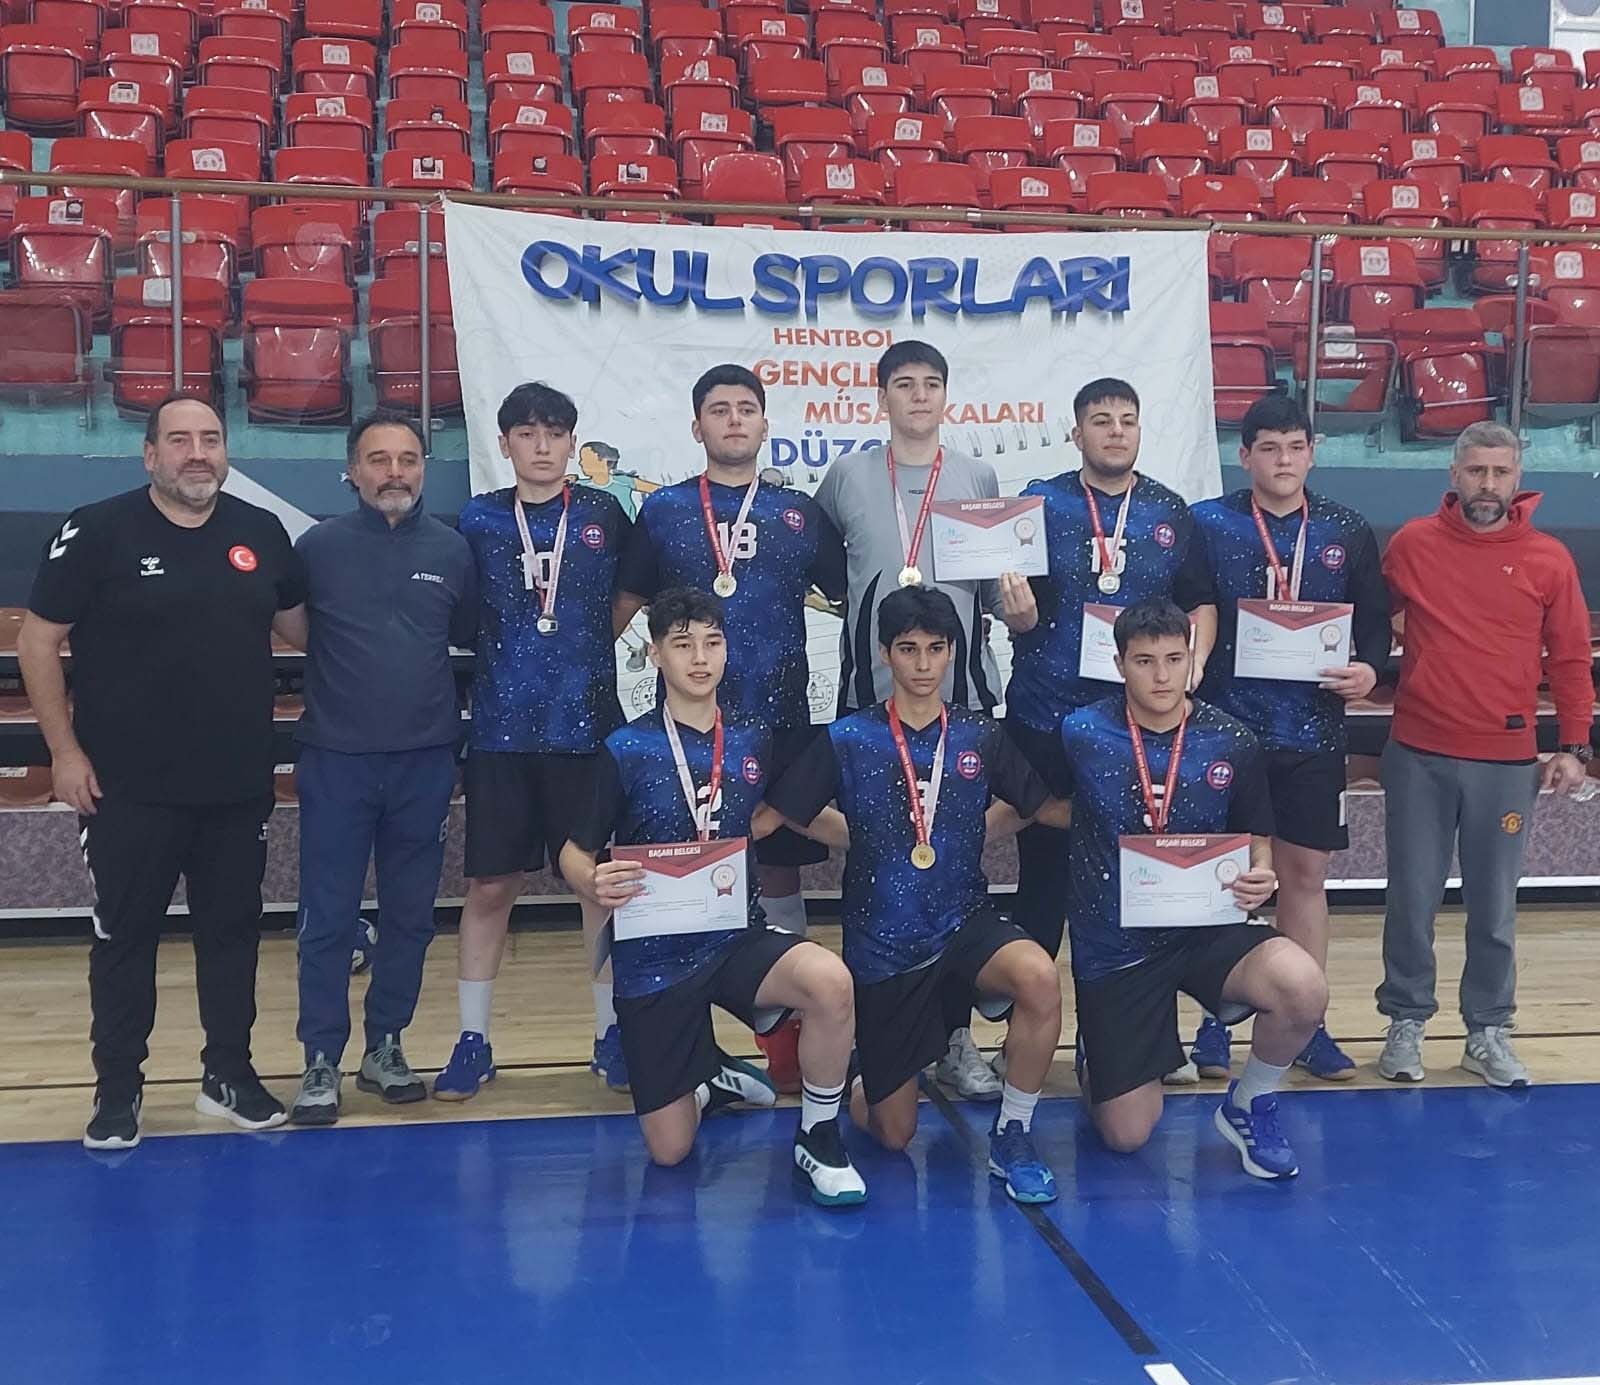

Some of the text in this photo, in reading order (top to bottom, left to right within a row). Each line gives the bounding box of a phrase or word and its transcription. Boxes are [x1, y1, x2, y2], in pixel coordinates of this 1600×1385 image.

[520, 240, 1131, 317] OKUL SPORLARI
[521, 551, 559, 590] 10
[696, 785, 722, 831] 2
